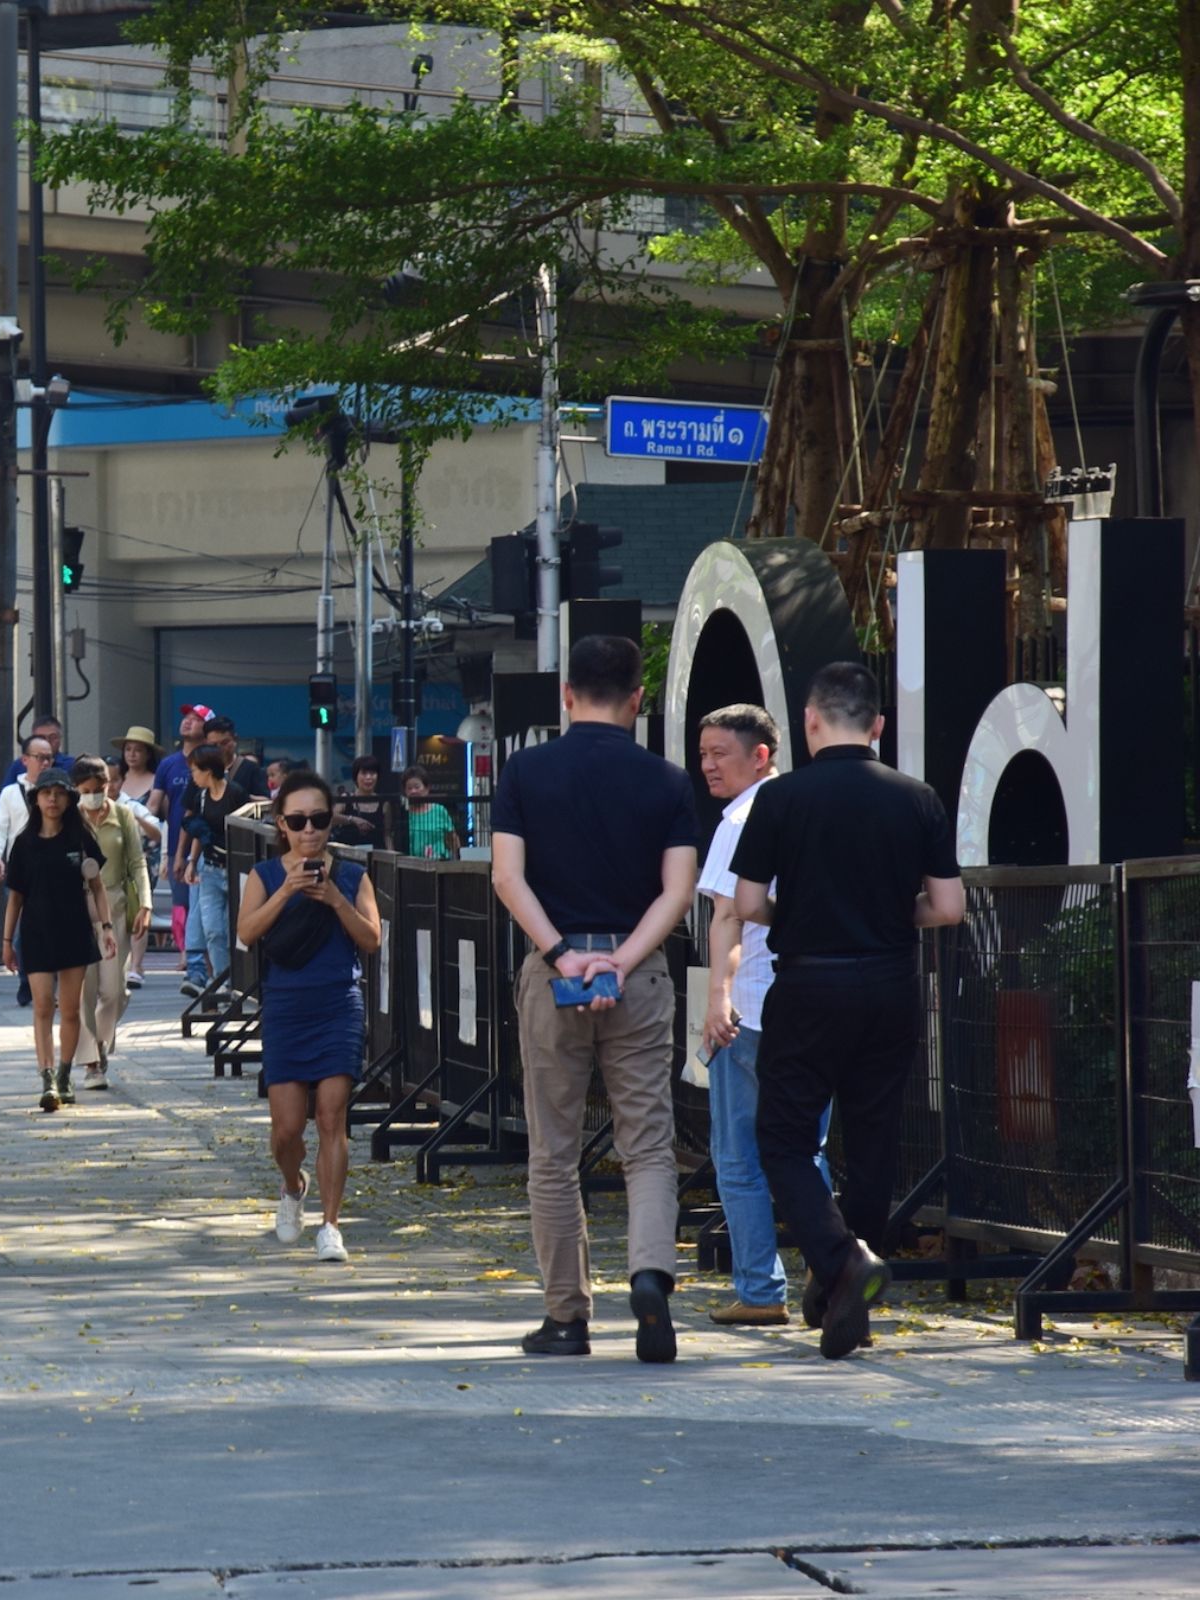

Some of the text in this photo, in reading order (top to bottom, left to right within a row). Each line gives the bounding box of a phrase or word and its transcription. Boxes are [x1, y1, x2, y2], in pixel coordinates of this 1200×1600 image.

[641, 409, 725, 443] พระรามที่
[728, 427, 744, 446] ๑
[646, 441, 683, 455] Rama
[696, 445, 717, 457] Rd.
